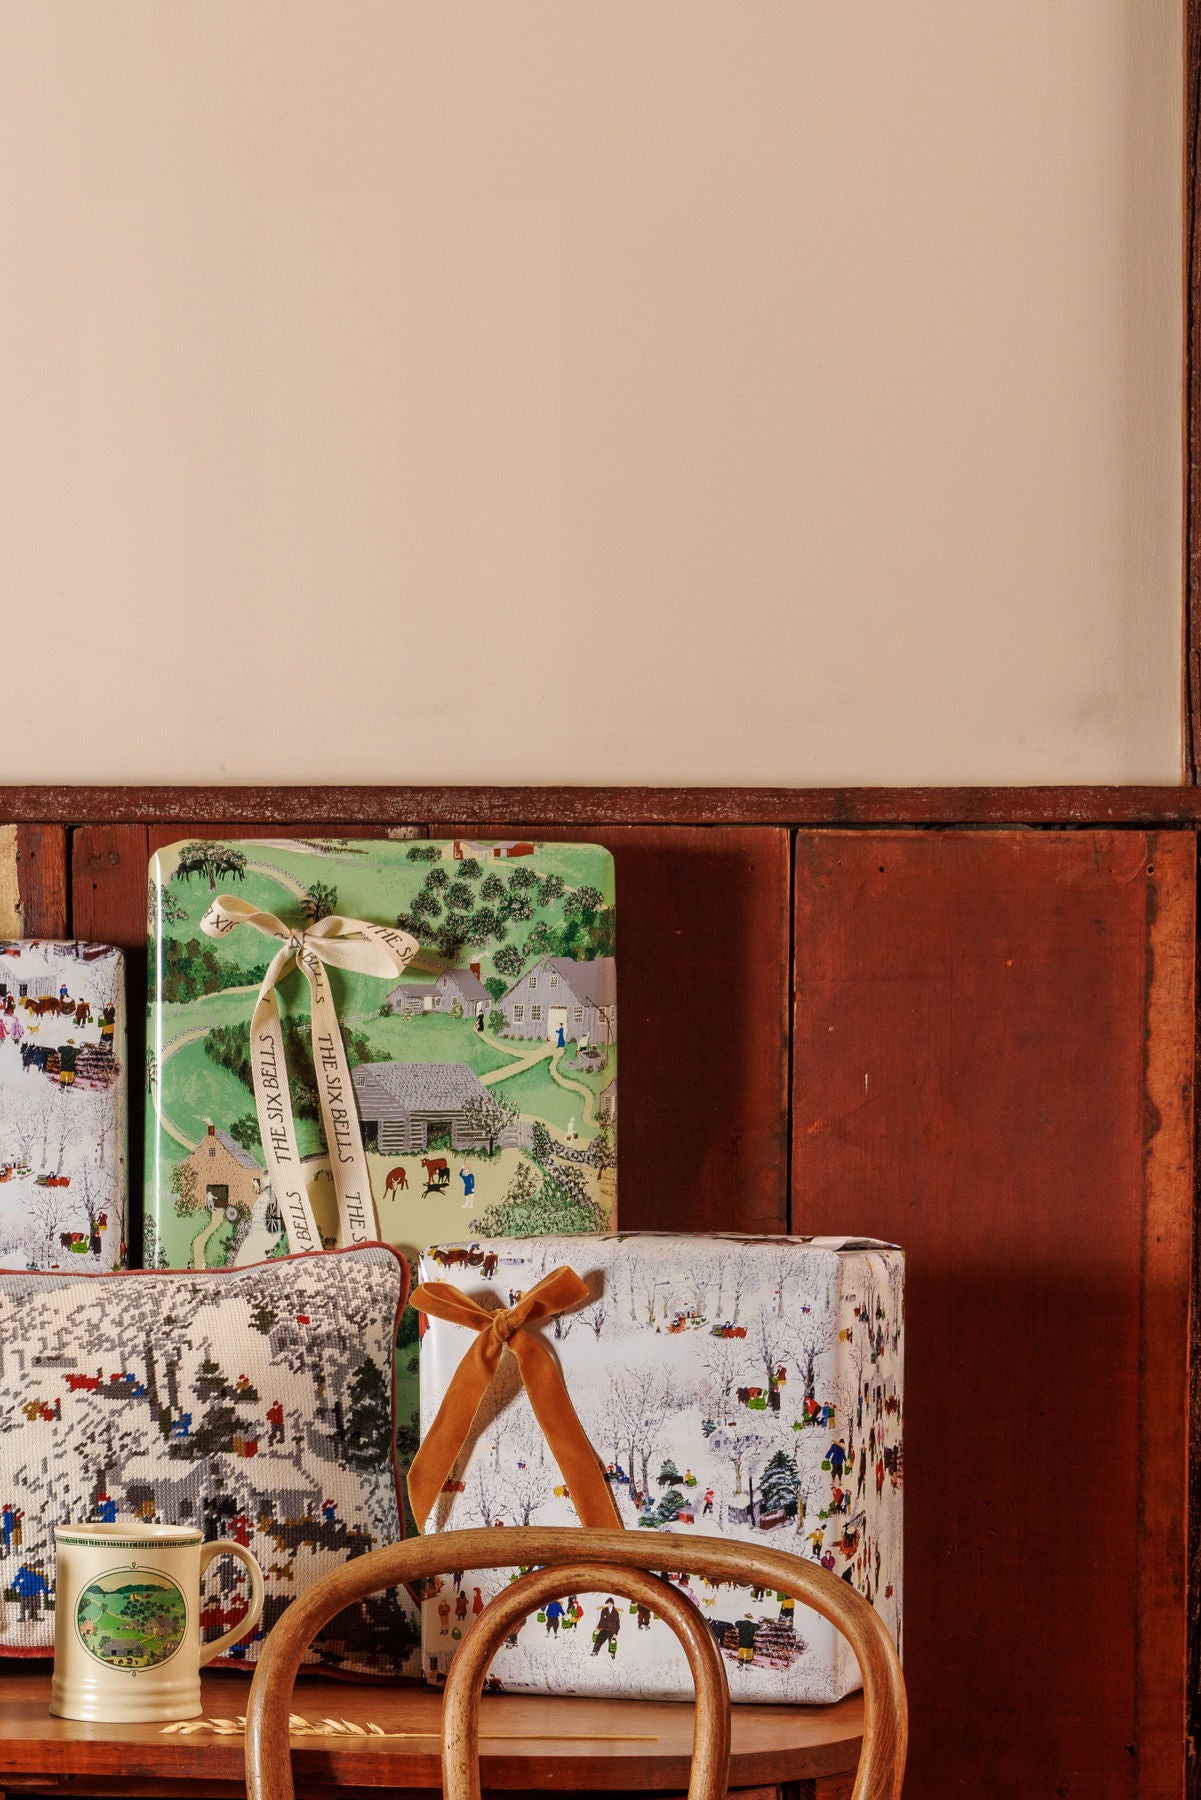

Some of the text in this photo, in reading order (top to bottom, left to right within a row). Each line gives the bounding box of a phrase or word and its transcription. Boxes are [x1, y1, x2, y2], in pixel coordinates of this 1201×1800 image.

[396, 947, 414, 966] SI
[259, 1034, 292, 1164] THE SIX BELLS
[317, 1033, 354, 1164] THE SIX BELLS
[286, 1191, 313, 1241] BELLS
[345, 1191, 366, 1230] THE
